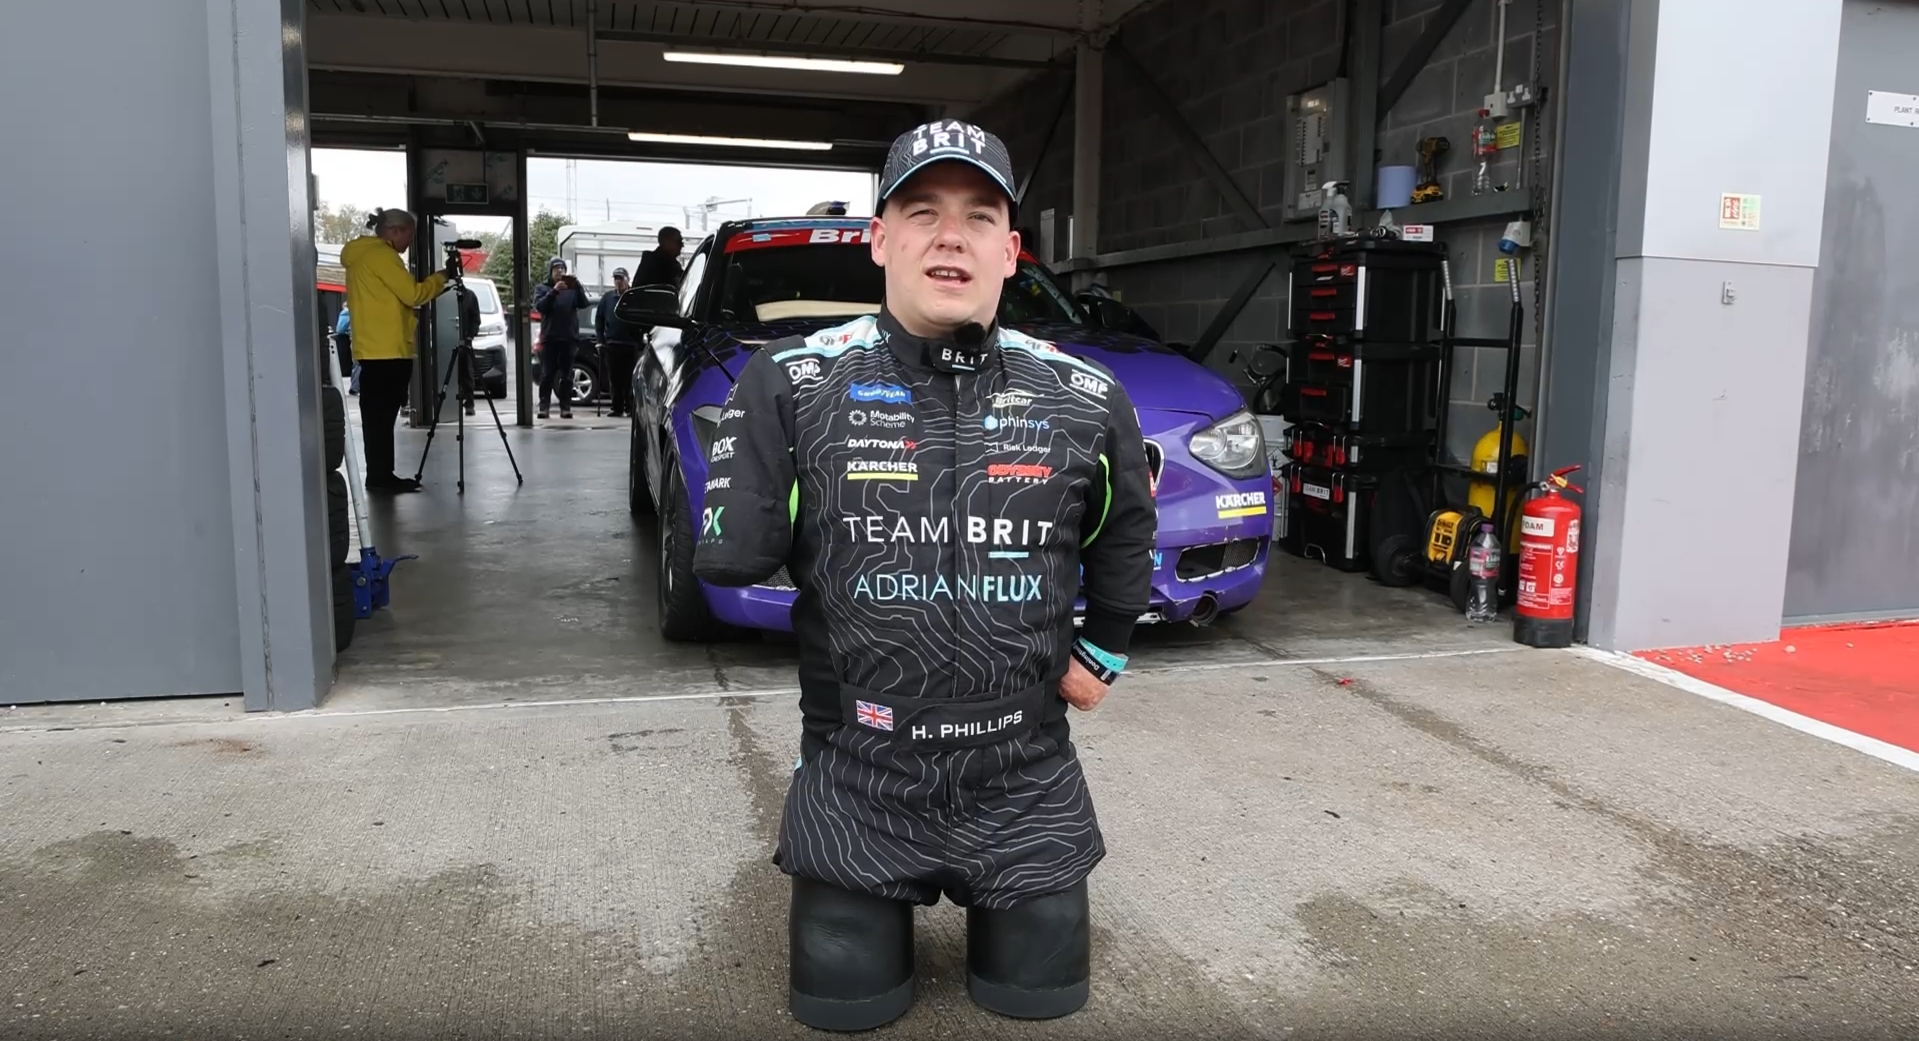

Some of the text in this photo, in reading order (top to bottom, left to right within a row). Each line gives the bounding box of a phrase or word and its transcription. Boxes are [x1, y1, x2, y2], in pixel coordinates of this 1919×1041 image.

[1894, 106, 1913, 114] PLANT
[913, 121, 986, 142] TEAM
[913, 133, 986, 156] BRIT
[789, 362, 821, 380] OMP
[1071, 373, 1108, 394] OMP
[870, 410, 915, 423] Motability
[870, 419, 906, 428] Scheme
[847, 439, 905, 449] DAYTONA
[1003, 443, 1051, 454] Risk Ledger
[988, 464, 1053, 478] ODYSSEY
[988, 477, 1049, 485] BATTERY
[842, 516, 1053, 546] TEAM BRIT
[911, 710, 1023, 740] H. PHILLIPS
